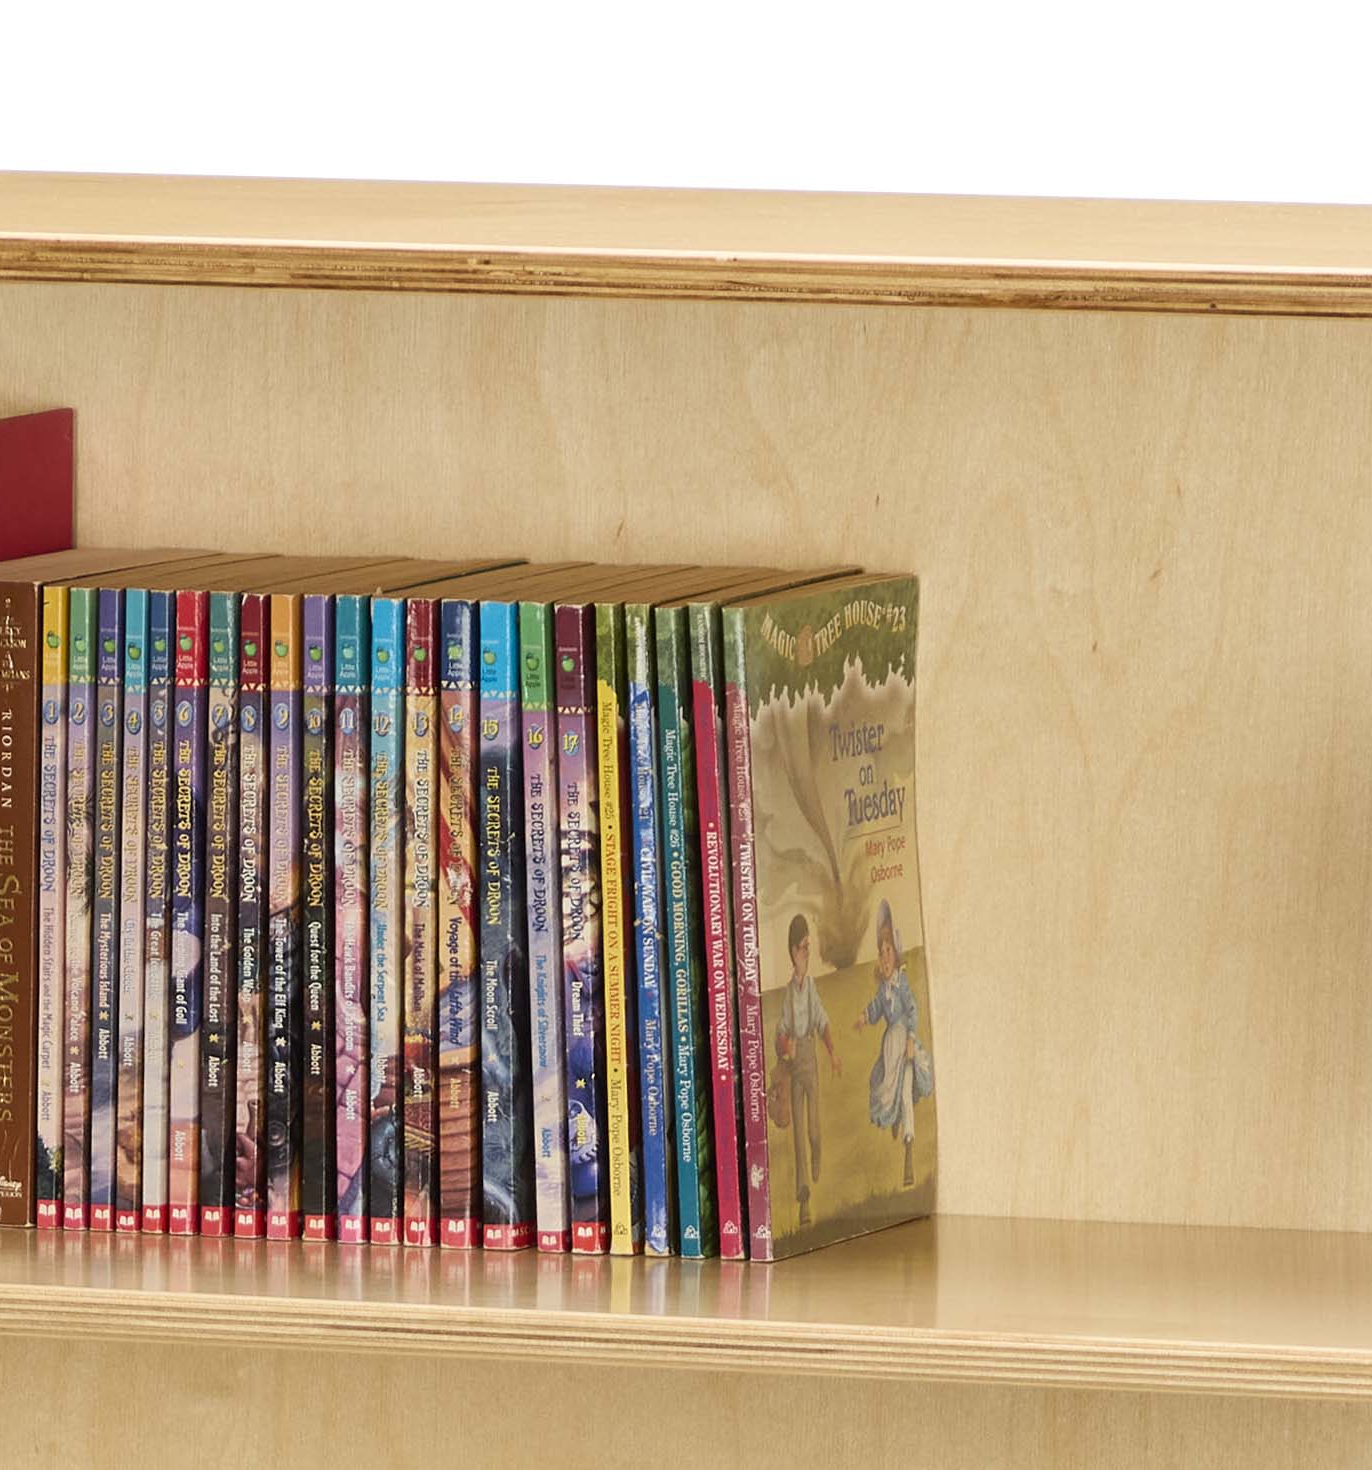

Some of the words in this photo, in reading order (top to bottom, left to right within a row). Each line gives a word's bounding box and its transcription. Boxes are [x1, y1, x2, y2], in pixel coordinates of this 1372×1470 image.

[760, 611, 796, 661] MAGIC
[813, 616, 843, 657] TREE
[844, 600, 881, 630] HOUSE
[482, 719, 499, 738] 15
[829, 721, 885, 762] Twister
[0, 708, 13, 809] RIORDAN
[859, 765, 874, 785] on
[487, 766, 501, 791] THE
[844, 780, 906, 827] Tuesday
[605, 833, 617, 875] STAGE
[671, 860, 683, 898] GOOD
[706, 831, 722, 938] REVOLUTIONARY
[606, 879, 619, 926] FRIGHT
[607, 930, 619, 947] ON
[672, 901, 685, 966] MORNING,
[486, 960, 498, 977] The
[608, 951, 619, 961] A
[711, 940, 724, 968] WAR
[486, 978, 498, 1004] Moon
[609, 965, 620, 1021] SUMMER
[713, 970, 725, 989] ON
[486, 1004, 499, 1030] Scroll
[677, 968, 689, 1033] GORILLAS
[610, 1023, 622, 1064] NIGHT
[715, 992, 729, 1071] WEDNESDAY
[677, 1044, 690, 1075] Mary
[486, 1091, 500, 1123] Abbott
[678, 1080, 691, 1109] Pope
[681, 1112, 693, 1162] Osborne
